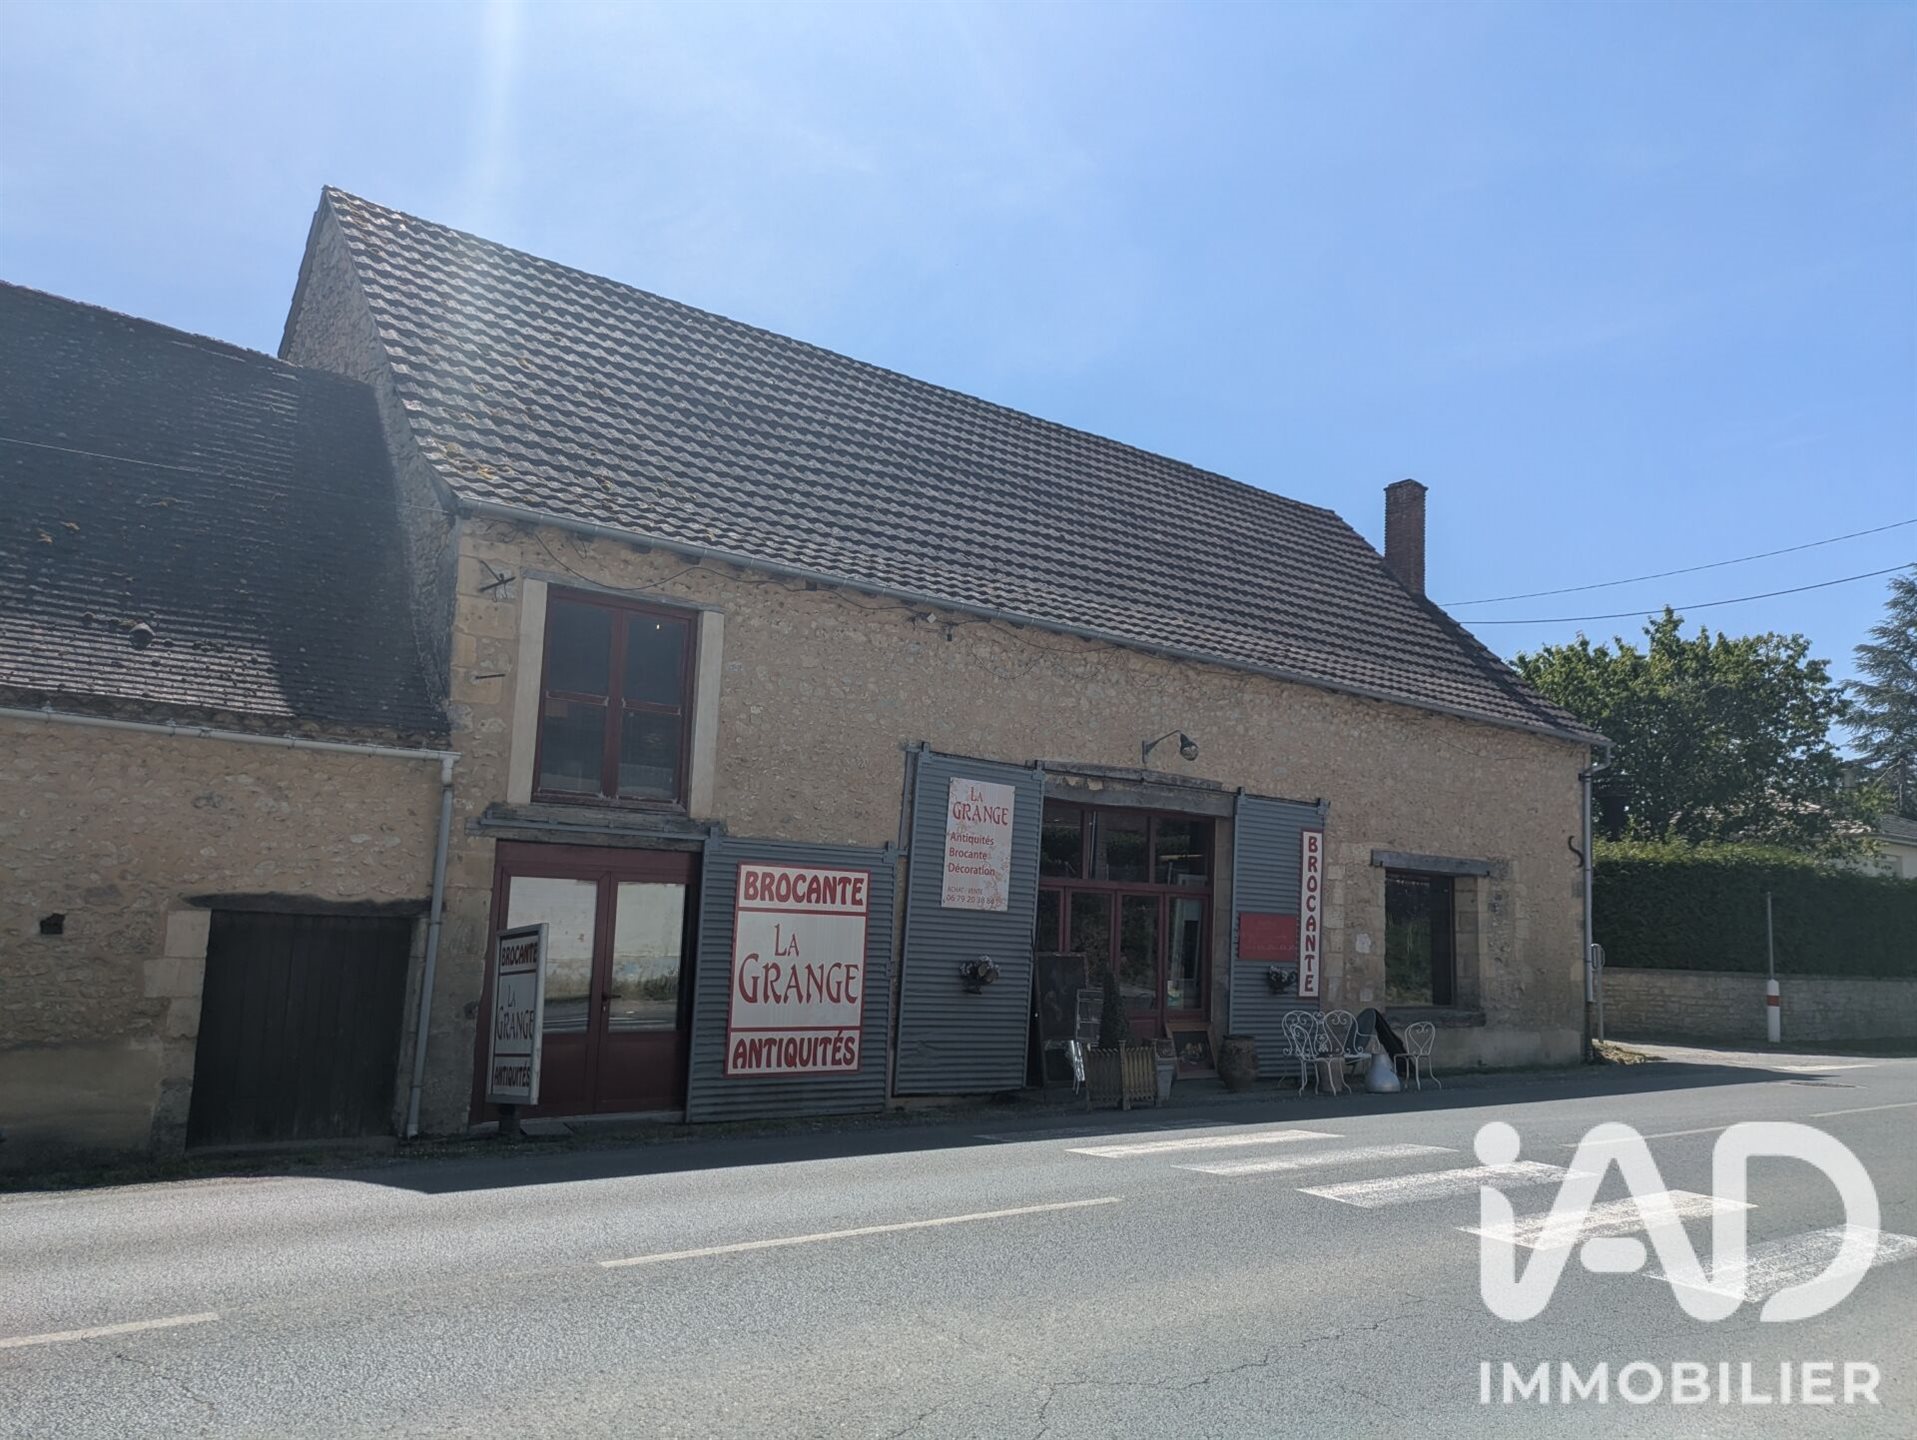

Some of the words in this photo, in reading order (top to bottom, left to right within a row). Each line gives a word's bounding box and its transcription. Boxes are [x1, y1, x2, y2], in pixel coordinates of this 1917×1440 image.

[952, 801, 1009, 826] GRANGE
[950, 831, 994, 846] Antiquités
[948, 862, 995, 876] Décoration
[949, 848, 987, 860] Brocante
[744, 871, 864, 906] BROCANTE
[1303, 836, 1318, 993] BROCANTE
[501, 942, 537, 966] BROCANTE
[774, 923, 800, 957] LA
[738, 953, 859, 1005] GRANGE
[496, 1006, 534, 1040] GRANGE
[732, 1031, 856, 1070] ANTIQUITÉS
[494, 1060, 530, 1086] ANTIQUITÉS
